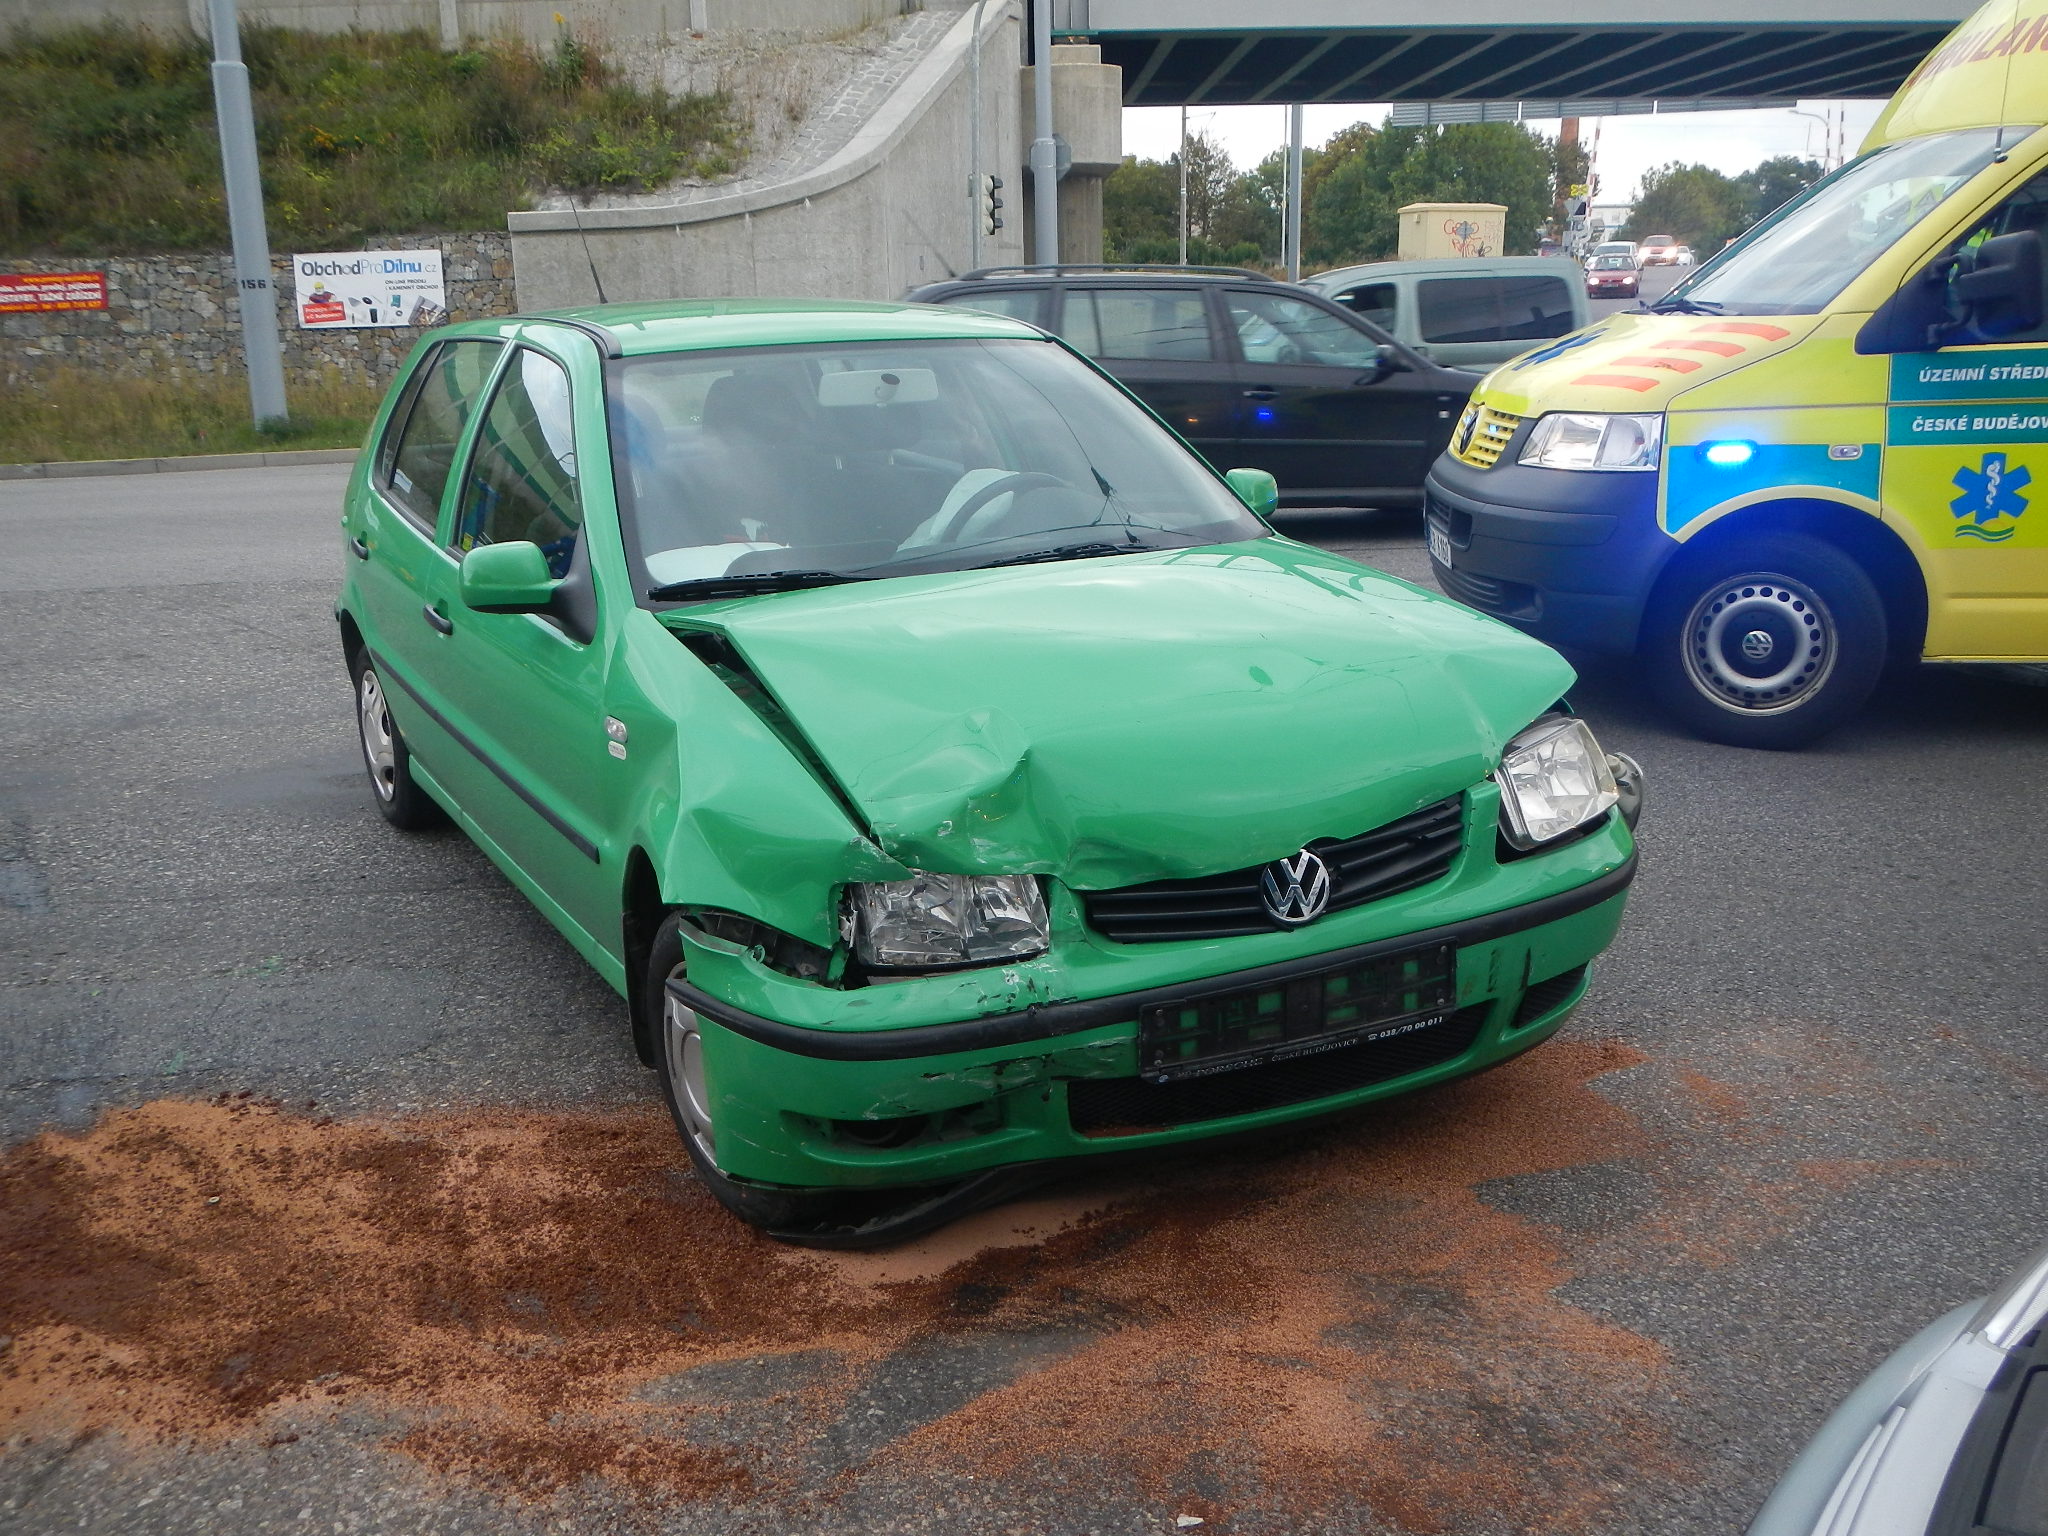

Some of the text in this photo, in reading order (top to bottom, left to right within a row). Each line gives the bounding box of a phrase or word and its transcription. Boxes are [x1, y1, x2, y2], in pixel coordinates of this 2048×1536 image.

[1919, 364, 1988, 383] ÚZEMNÍ
[1912, 415, 1968, 432] ČESKÉ
[1379, 1024, 1413, 1039] 038/70
[1414, 1020, 1426, 1031] 00
[1427, 1016, 1443, 1027] 011
